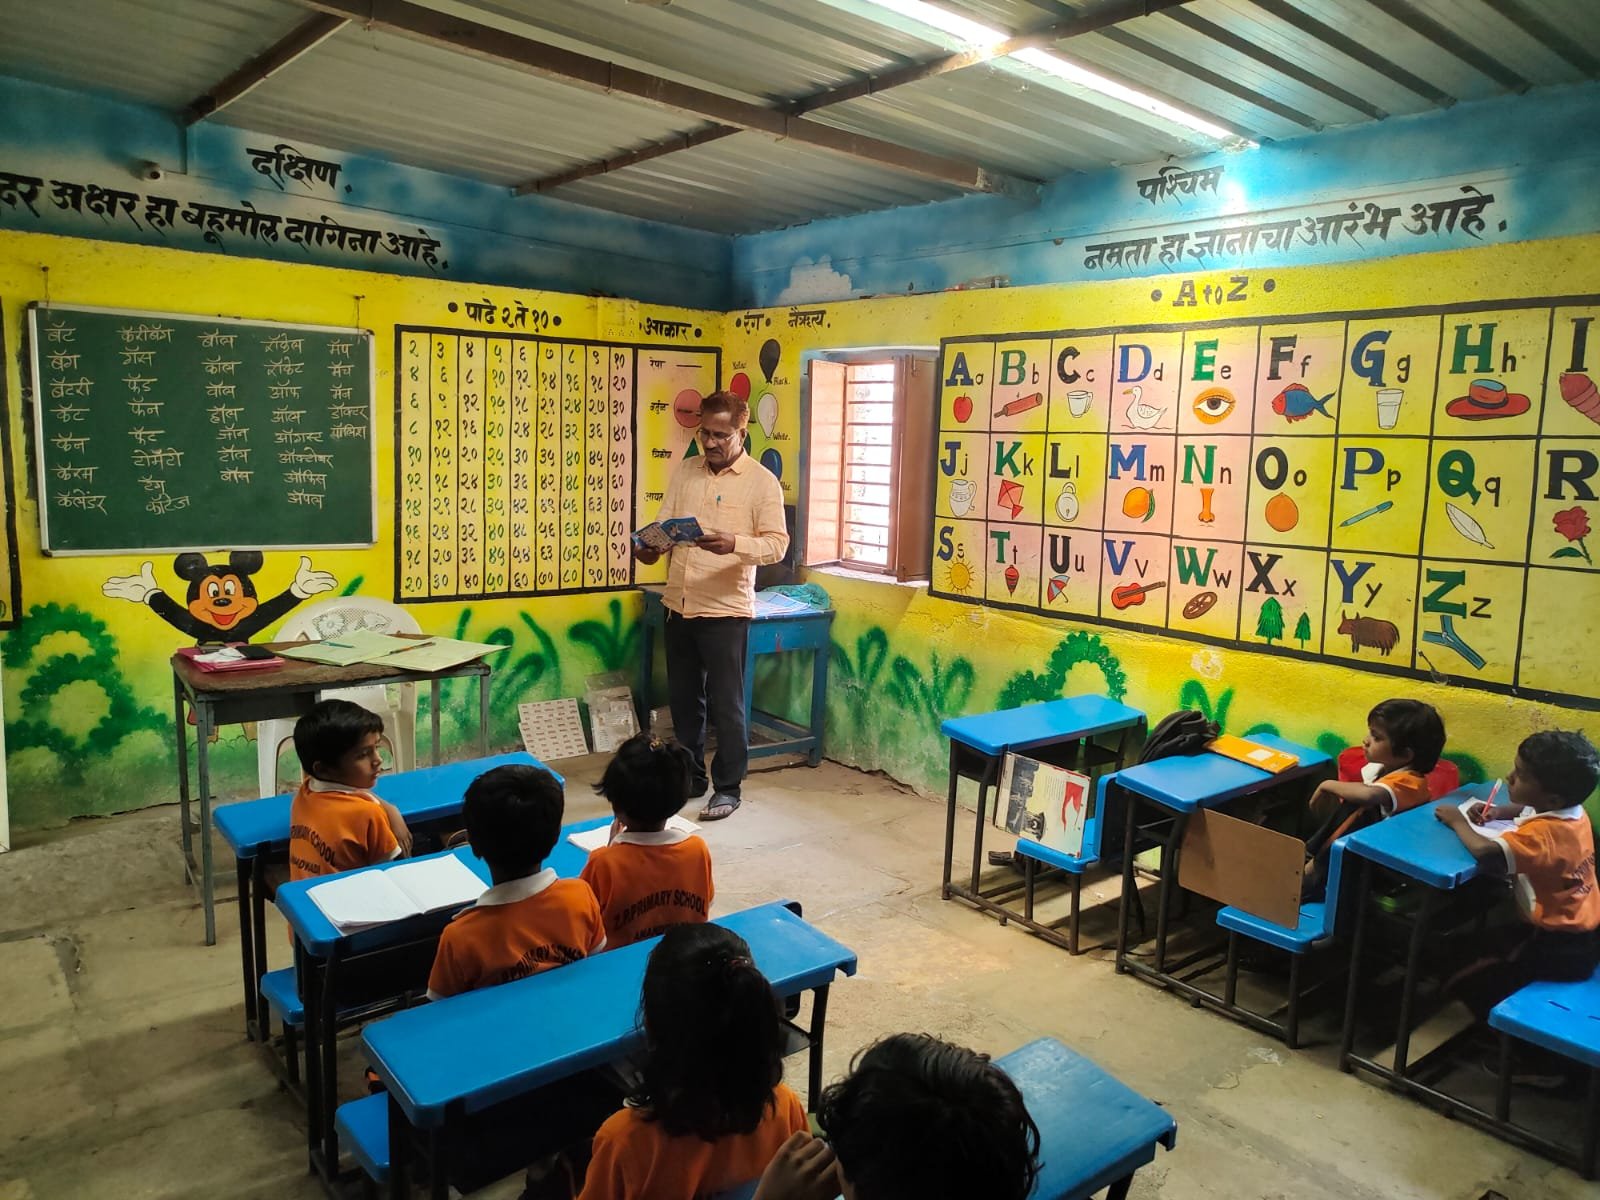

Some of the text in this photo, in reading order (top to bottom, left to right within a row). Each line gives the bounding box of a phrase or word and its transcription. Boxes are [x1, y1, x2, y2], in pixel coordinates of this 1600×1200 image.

[1137, 166, 1224, 206] पश्चिम
[49, 180, 143, 232] अक्षर
[145, 195, 180, 237] हा
[284, 215, 382, 254] दागिना
[1083, 237, 1157, 273] नम्रता
[1158, 233, 1190, 273] हा
[1297, 202, 1401, 250] आरंभ
[1172, 280, 1197, 307] A
[1227, 276, 1249, 301] Z
[465, 299, 497, 324] पाढे
[532, 309, 549, 332] १०
[644, 317, 692, 341] आकार
[744, 311, 764, 334] रंग
[1565, 317, 1595, 374] I
[1543, 450, 1600, 501] R
[673, 889, 706, 918] SCHOOL
